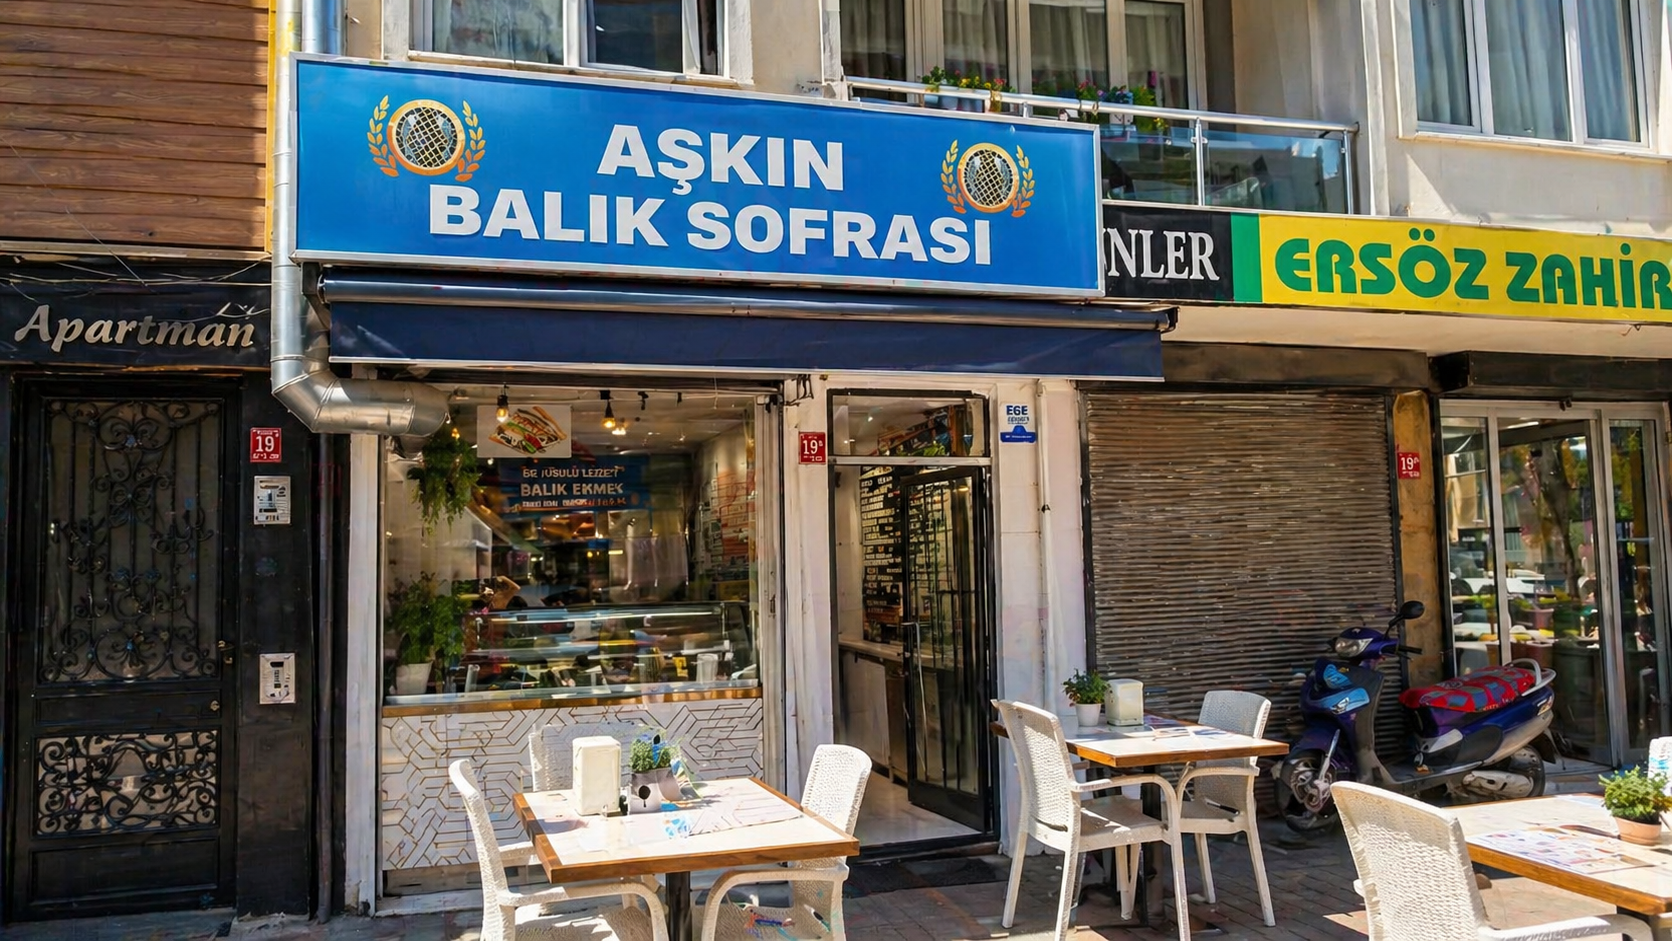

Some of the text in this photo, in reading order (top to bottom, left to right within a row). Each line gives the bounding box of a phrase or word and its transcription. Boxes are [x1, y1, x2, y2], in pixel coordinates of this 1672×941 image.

[596, 123, 844, 196] AŞKIN
[428, 184, 992, 266] BALIK SOFRASI
[1102, 227, 1220, 281] NLER
[1275, 228, 1672, 310] ERSÖZ ZAHİR
[14, 304, 256, 353] Apartman
[255, 435, 275, 452] 19
[520, 482, 624, 497] BALIK EKMEK
